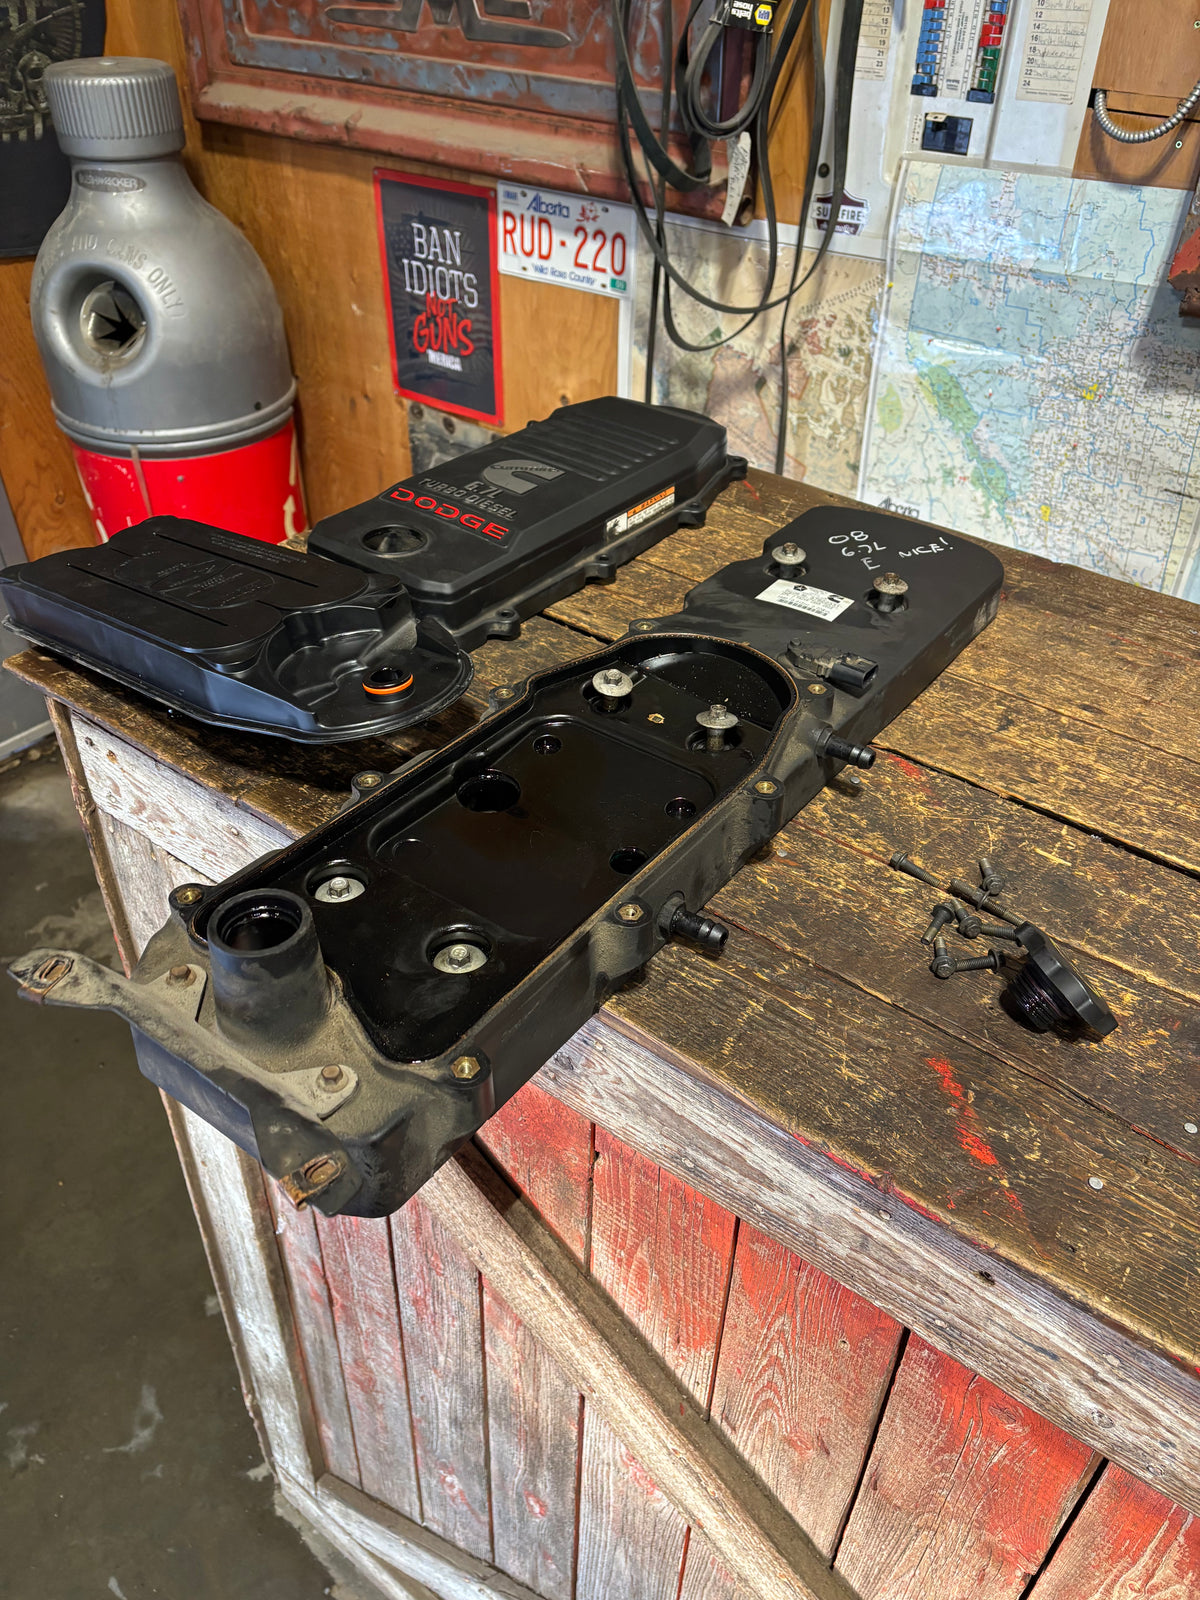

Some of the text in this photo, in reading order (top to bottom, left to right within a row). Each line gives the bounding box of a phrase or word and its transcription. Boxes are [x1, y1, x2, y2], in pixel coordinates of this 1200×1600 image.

[731, 8, 752, 20] belts
[733, 0, 754, 11] hose
[883, 6, 890, 14] 13
[881, 17, 889, 25] 15
[880, 28, 888, 36] 17
[1031, 34, 1039, 42] 16
[526, 192, 570, 219] Alberta
[411, 222, 462, 266] BAN
[402, 258, 479, 308] IDIOTS
[569, 271, 596, 286] Country
[425, 290, 458, 321] NOT
[412, 312, 475, 357] GUNS
[419, 478, 518, 519] TURBO DIESEL
[464, 481, 504, 499] 6.7L
[389, 487, 510, 540] DODGE
[878, 496, 919, 519] Alberta
[828, 530, 869, 544] 08
[841, 541, 887, 557] 6.7L
[898, 536, 954, 558] NICE!
[860, 557, 881, 570] E
